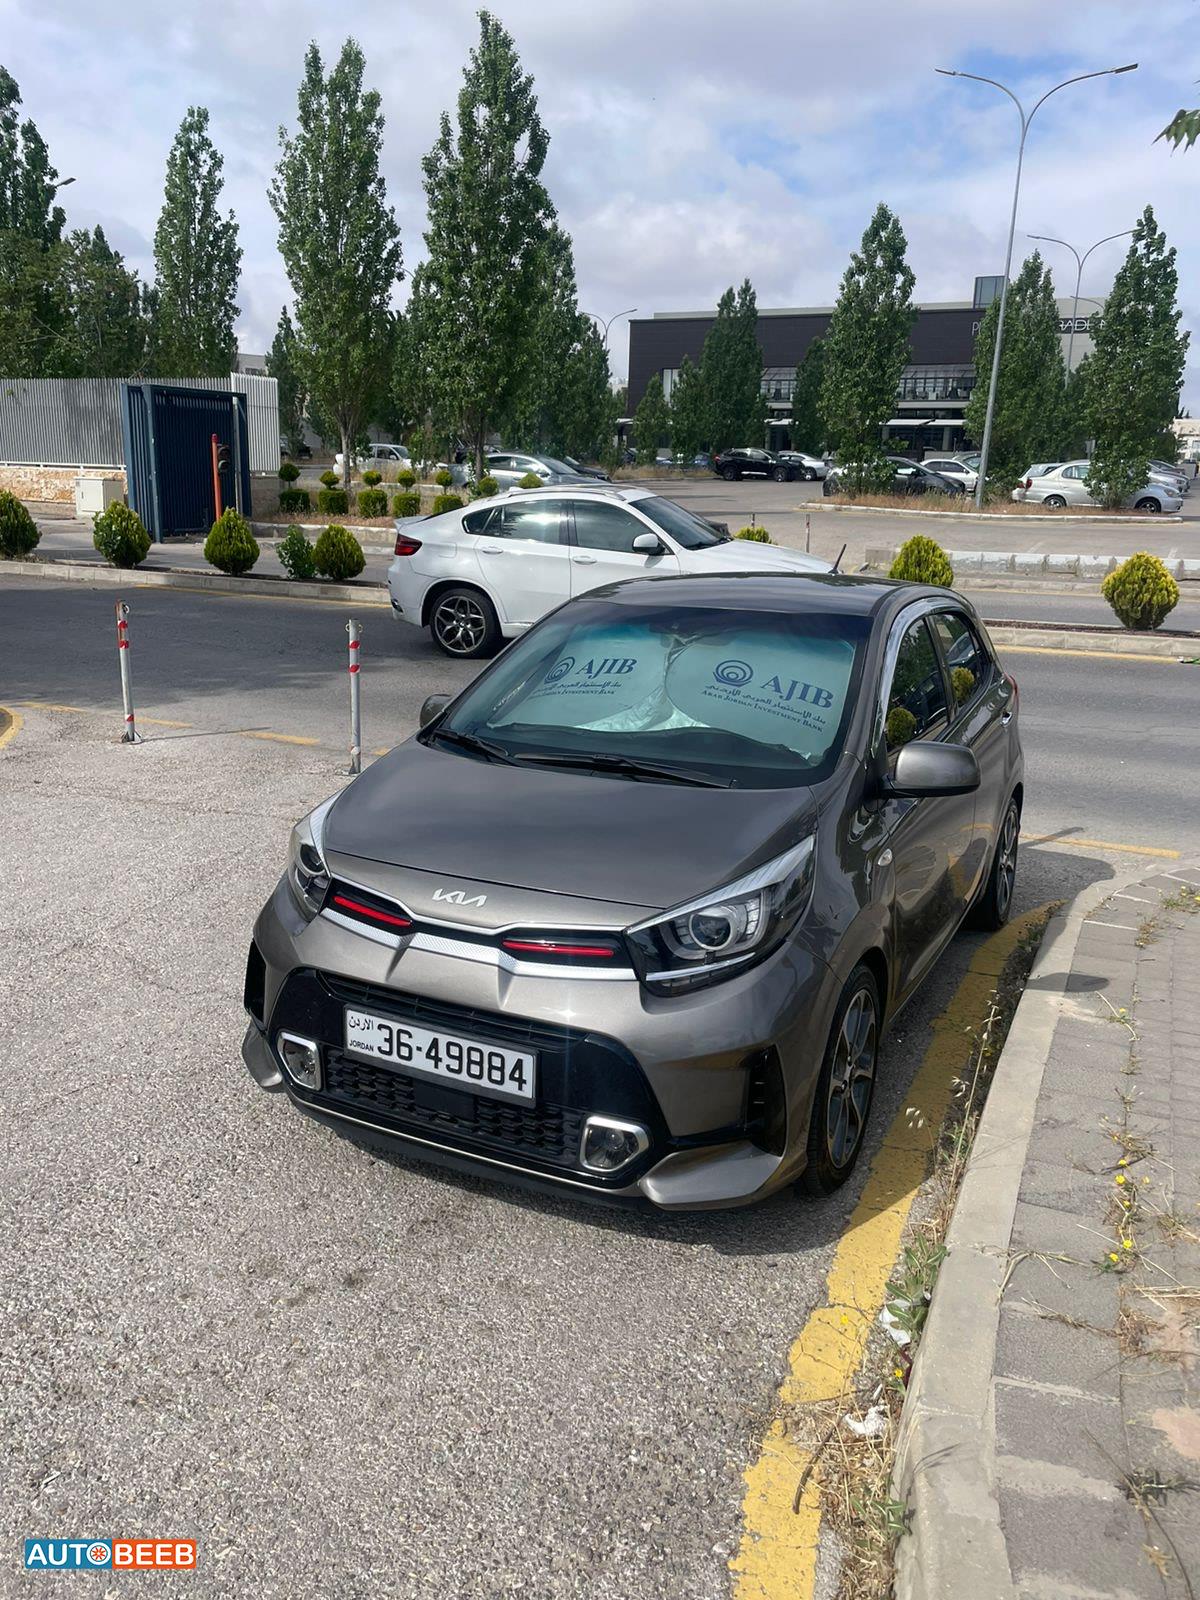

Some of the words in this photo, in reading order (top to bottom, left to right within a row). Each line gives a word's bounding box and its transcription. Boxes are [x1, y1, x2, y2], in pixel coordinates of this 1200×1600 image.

[575, 658, 637, 679] AJIB
[760, 675, 834, 709] AJIB
[753, 703, 801, 724] INVESTMENT
[802, 719, 823, 733] BANK
[432, 888, 487, 907] KIA
[349, 1039, 374, 1052] JORDAN
[377, 1023, 527, 1092] 36-49884
